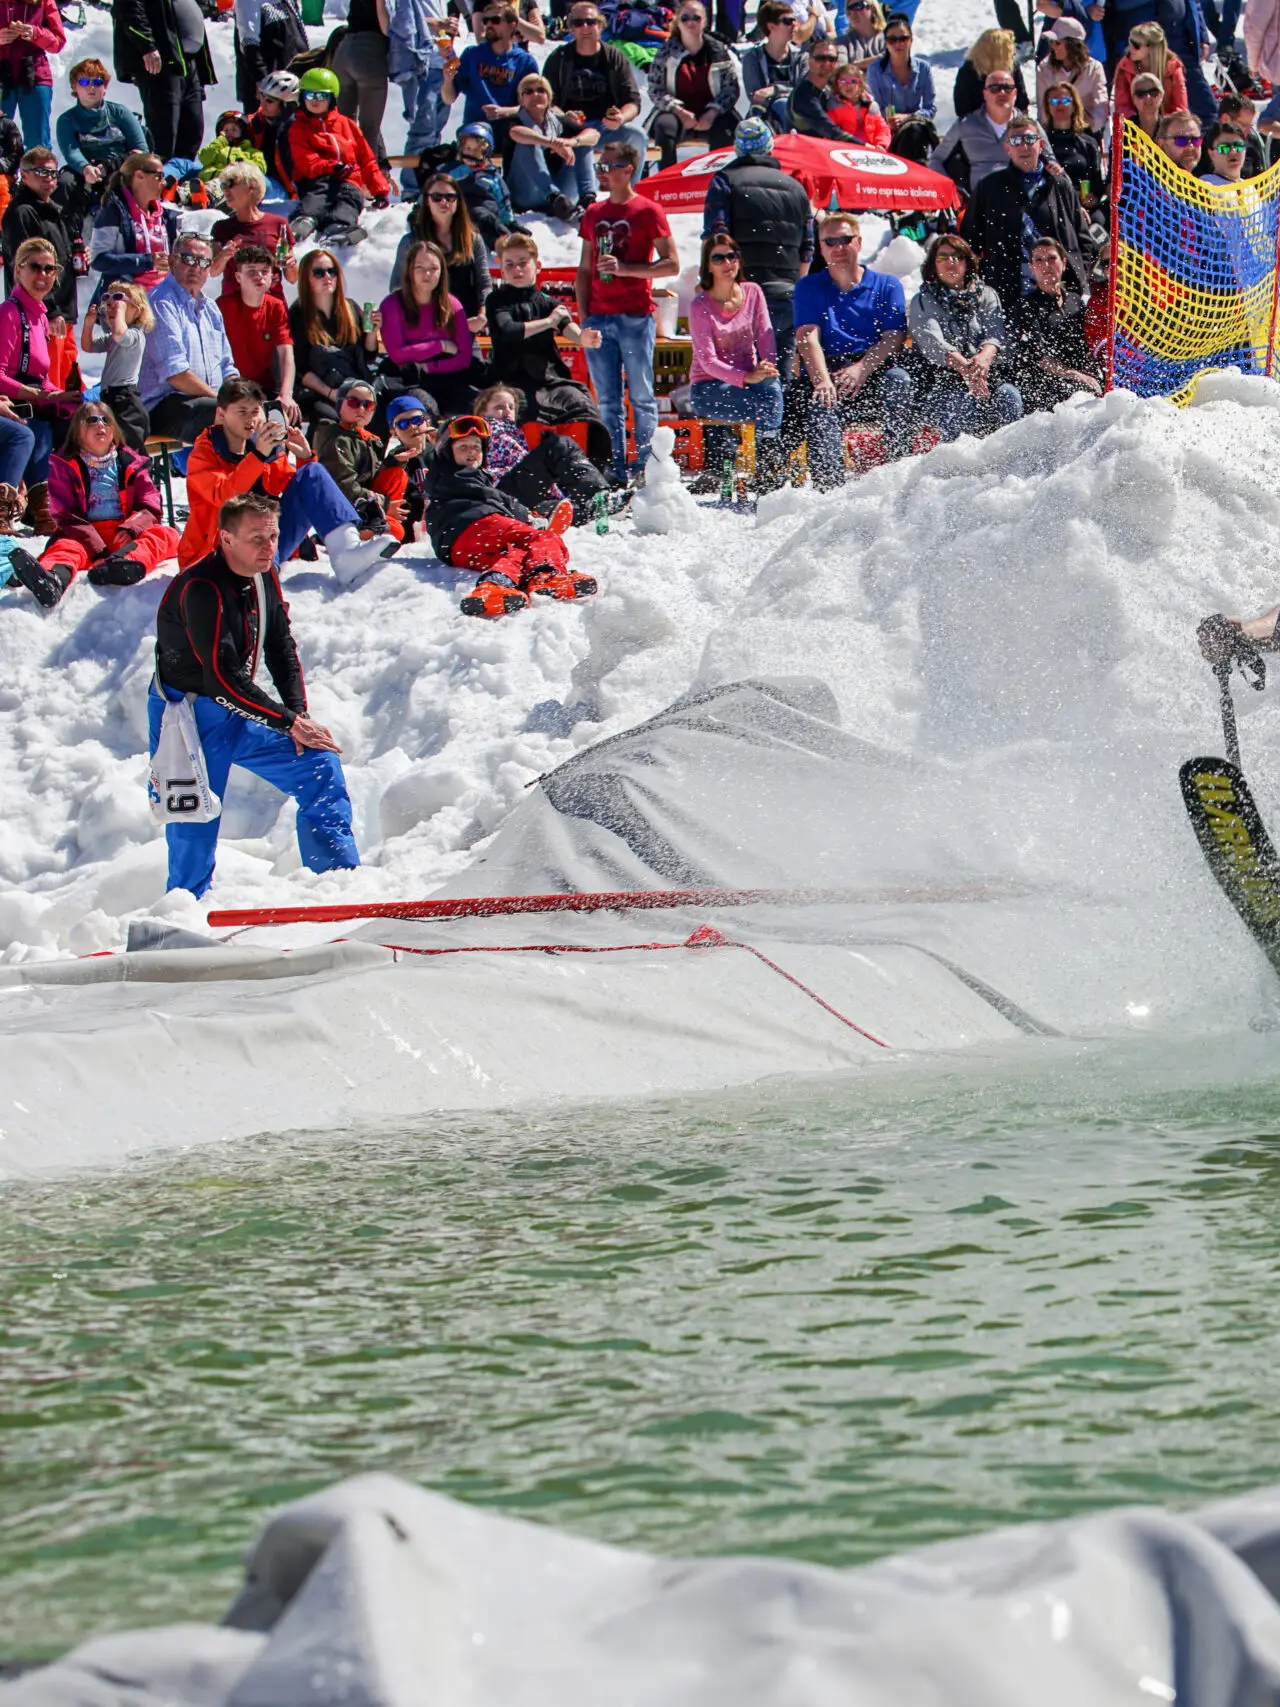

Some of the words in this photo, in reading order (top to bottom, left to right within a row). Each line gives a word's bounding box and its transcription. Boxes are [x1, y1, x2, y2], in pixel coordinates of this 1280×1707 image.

[660, 192, 678, 200] vero
[862, 186, 877, 195] vero
[878, 187, 909, 198] espresso
[909, 185, 938, 198] italiano
[215, 696, 268, 725] ORTEMA
[166, 777, 200, 814] 61
